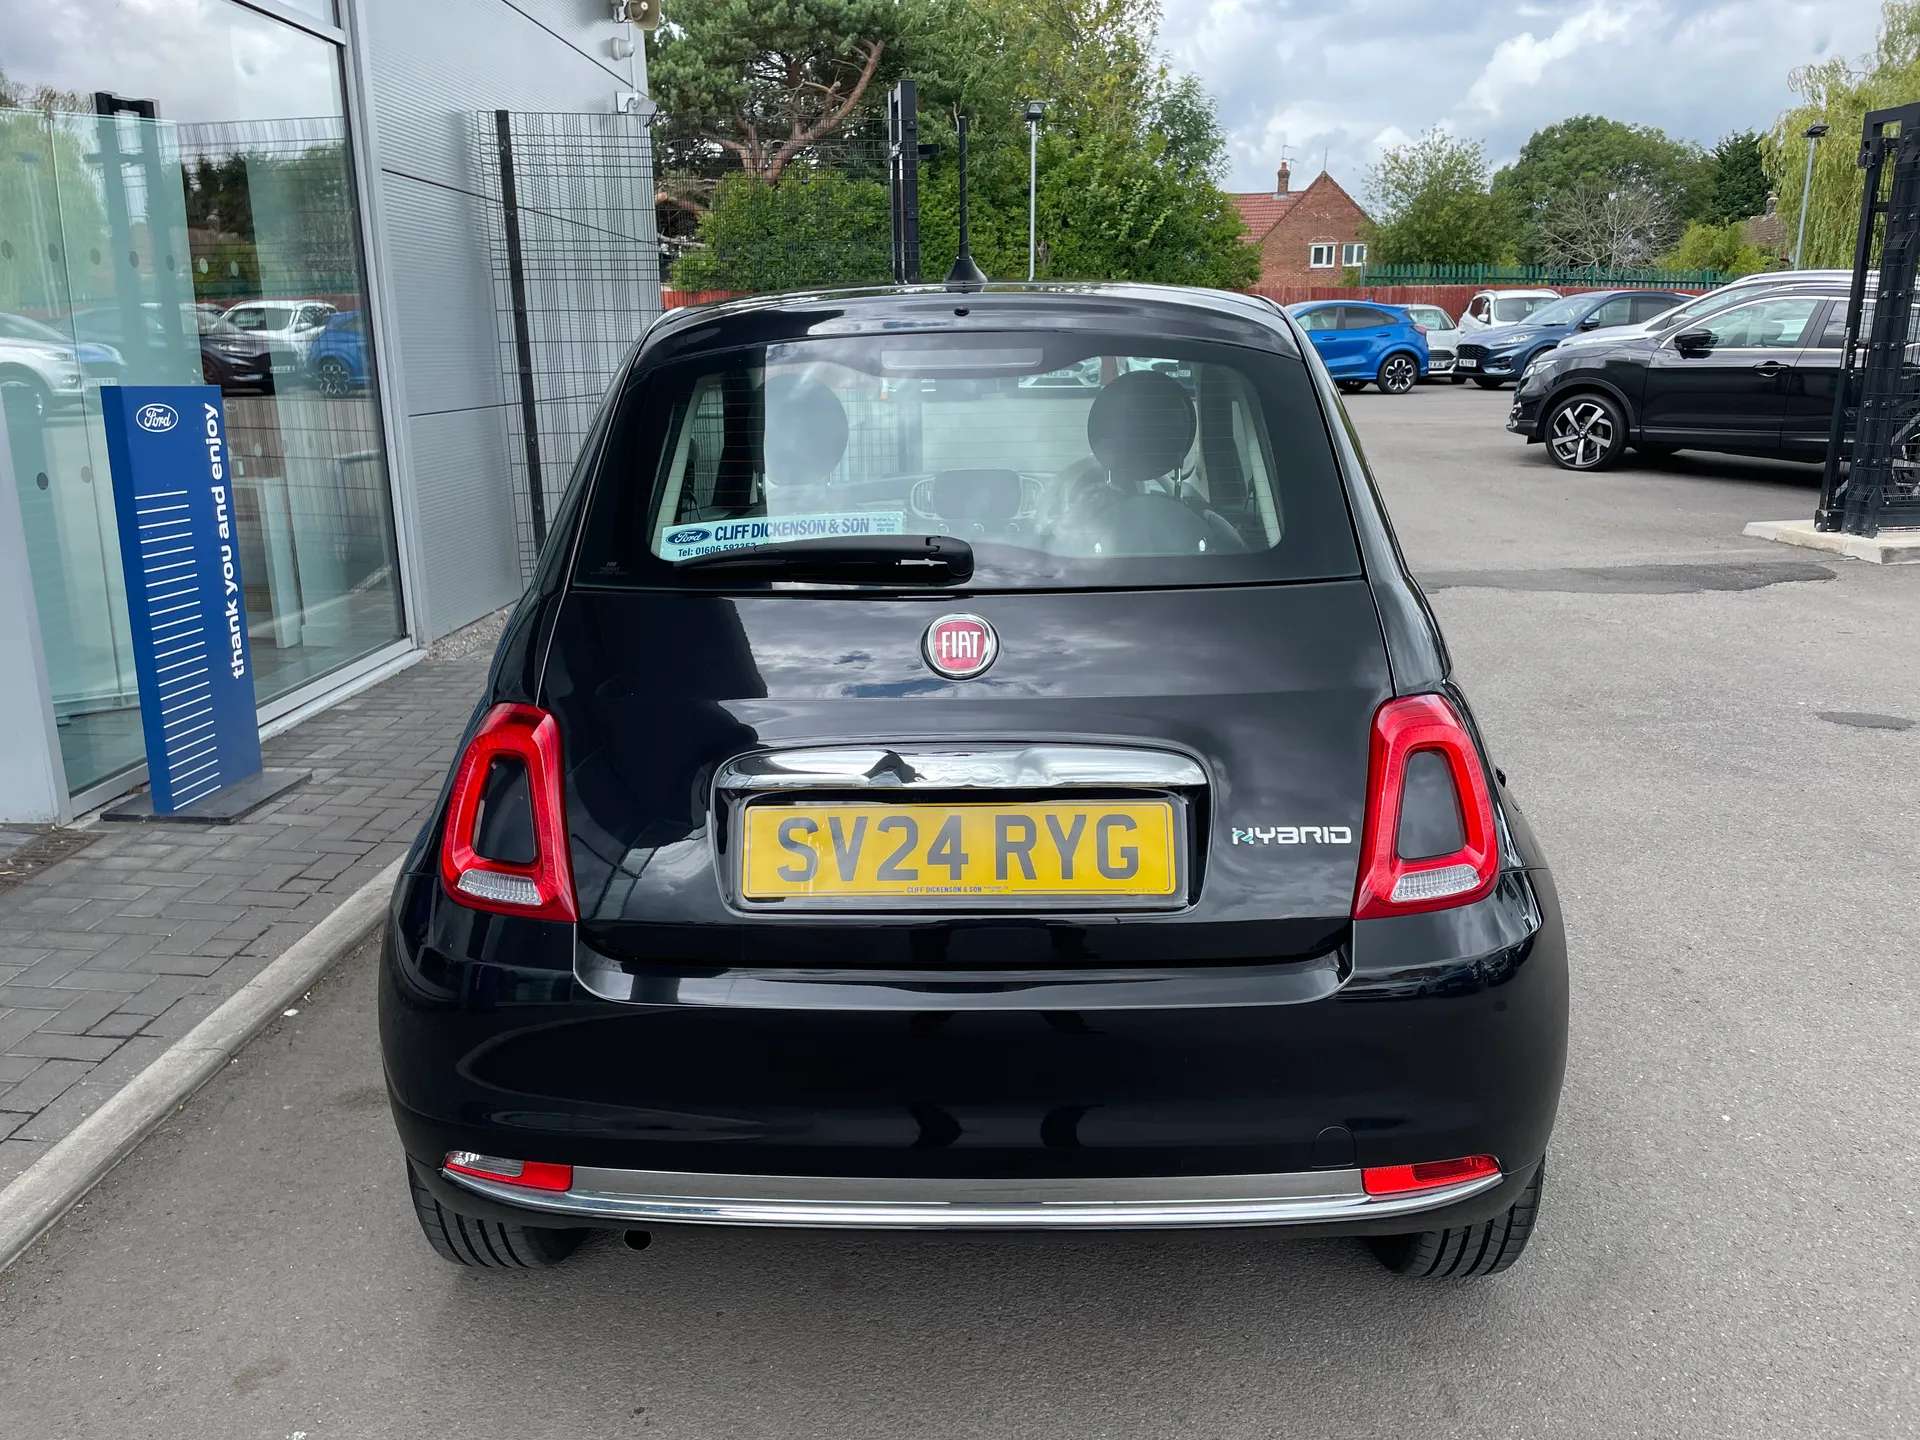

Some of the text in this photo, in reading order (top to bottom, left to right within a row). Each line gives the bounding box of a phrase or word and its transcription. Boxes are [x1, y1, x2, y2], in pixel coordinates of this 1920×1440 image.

[143, 406, 172, 428] Ford
[204, 402, 246, 679] thank you and enjoy
[673, 531, 703, 543] Ford
[715, 524, 750, 541] CLIFF
[751, 519, 826, 538] DICKENSON
[828, 519, 840, 534] &
[842, 518, 870, 533] SON
[678, 548, 694, 558] Tel:
[941, 631, 981, 658] FIAT
[1231, 826, 1353, 845] HYBRID
[776, 813, 1140, 882] SV24 RYG
